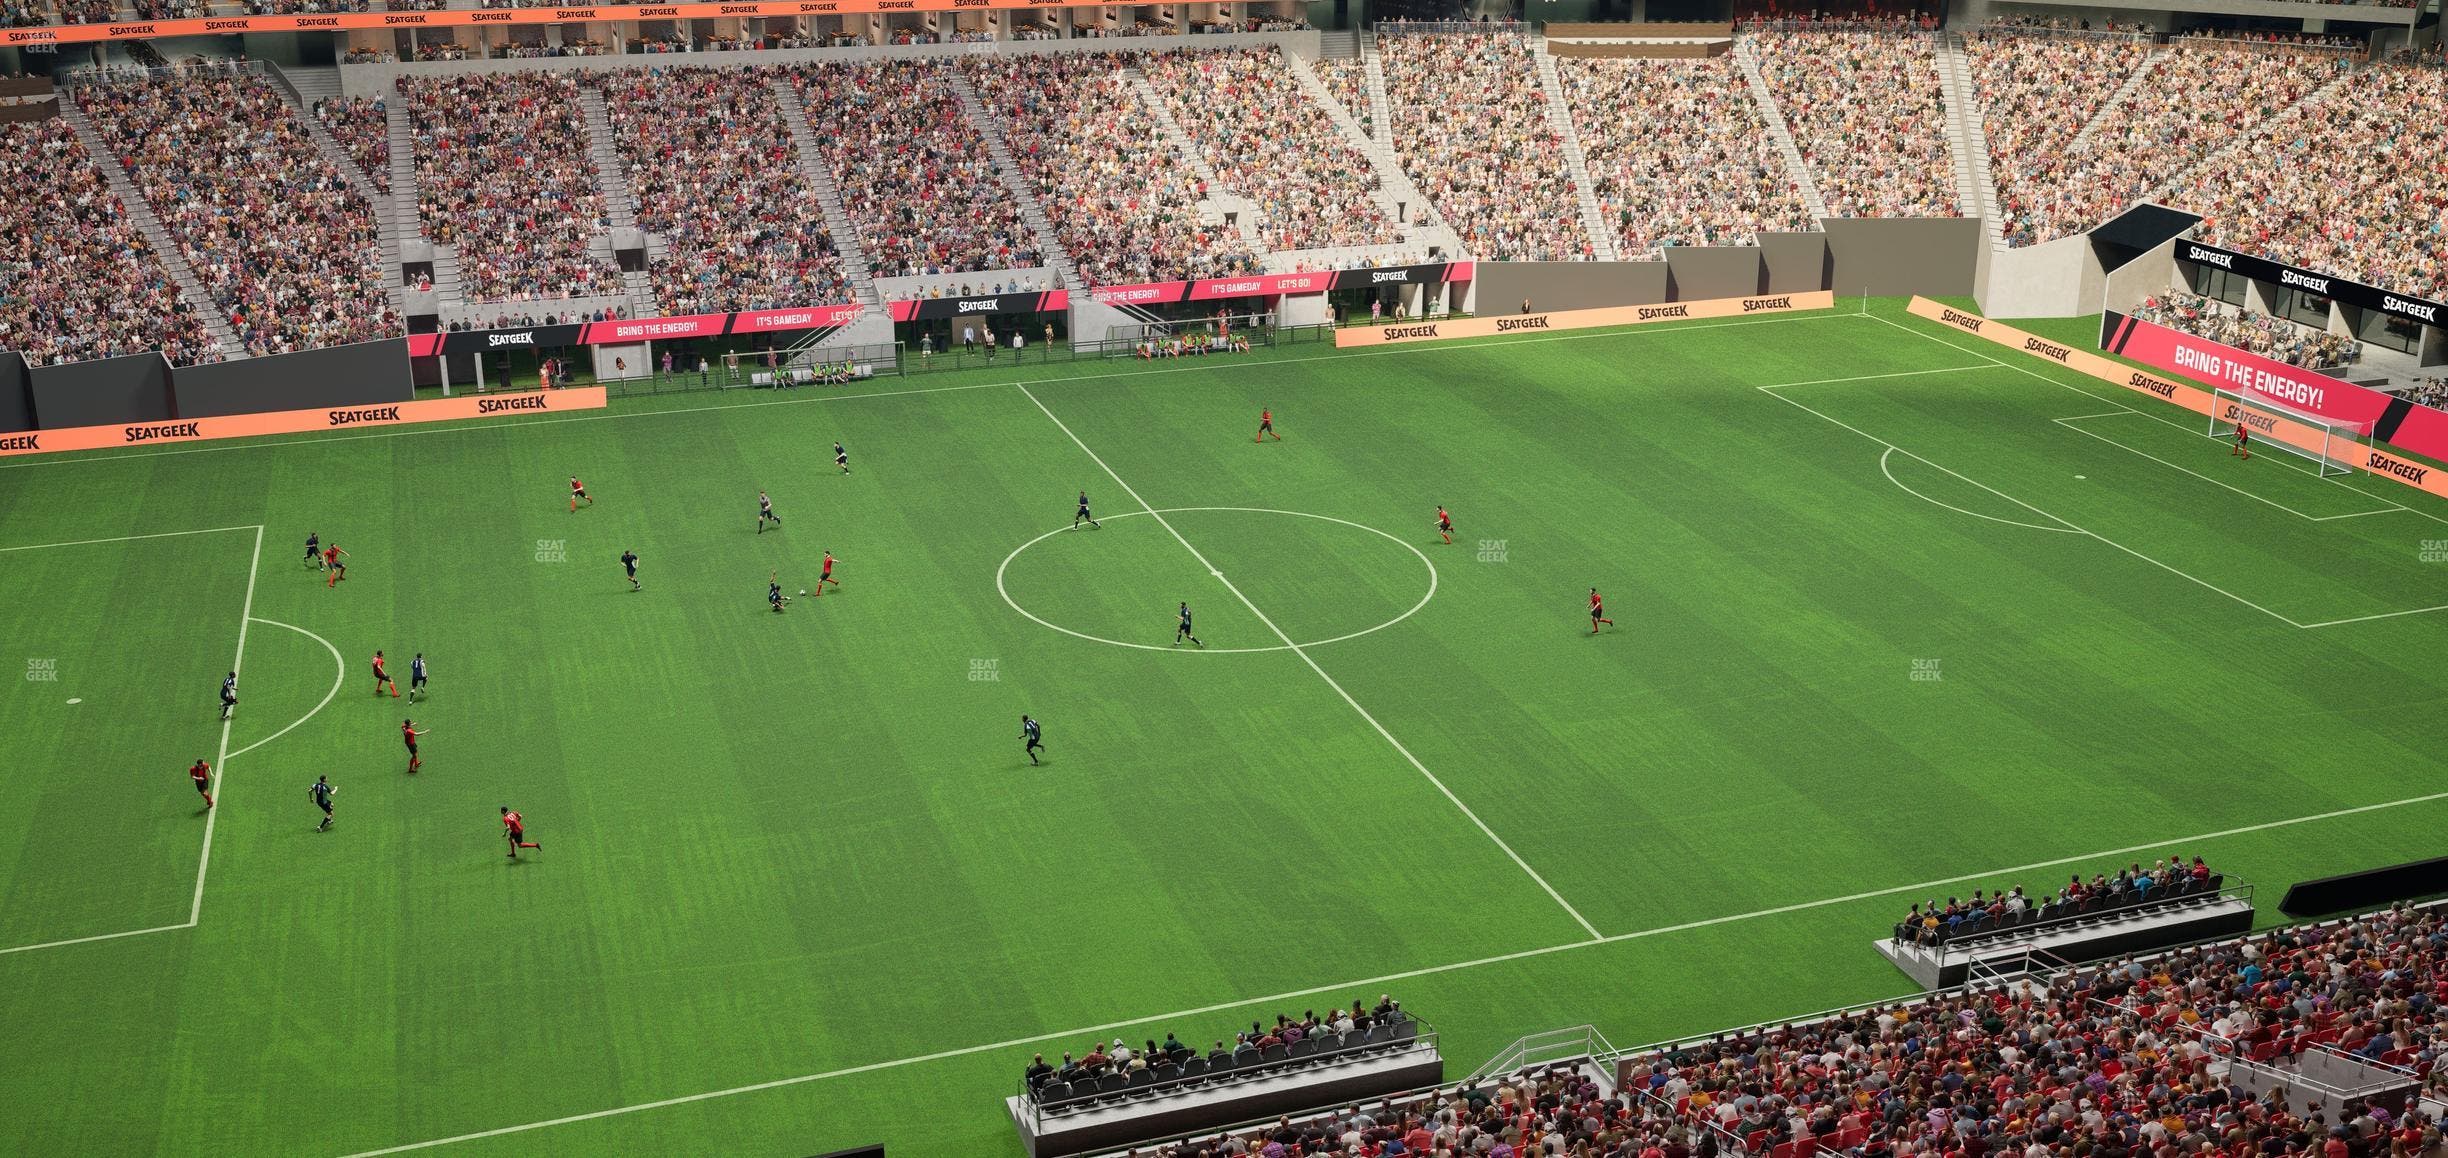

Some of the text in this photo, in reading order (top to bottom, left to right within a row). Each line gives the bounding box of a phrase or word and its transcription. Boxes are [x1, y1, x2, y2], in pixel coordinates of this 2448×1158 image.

[639, 7, 678, 17] SEATGEEK
[721, 5, 758, 15] SEATGEEK
[800, 2, 838, 12] SEATGEEK
[878, 0, 914, 10] SEATGEEK
[385, 14, 426, 25] SEATGEEK
[472, 11, 512, 22] SEATGEEK
[556, 9, 596, 20] SEATGEEK
[205, 19, 249, 31] SEATGEEK
[296, 17, 339, 27] SEATGEEK
[8, 30, 57, 42] SEATGEEK
[109, 24, 156, 37] SEATGEEK
[1372, 269, 1408, 283] SEATGEEK
[1211, 283, 1225, 294] IT'S
[1226, 281, 1261, 293] GAMEDAY
[1277, 279, 1297, 289] LET'S
[2189, 245, 2437, 323] SEATGEEK SEATGEEK SEATGEEK
[1128, 288, 1160, 300] ENERGY!
[959, 298, 998, 313] SEATGEEK
[1742, 297, 1791, 312] SEATGEEK
[1638, 305, 1688, 320] SEATGEEK
[756, 315, 772, 327] IT'S
[773, 313, 813, 326] GAMEDAY
[1496, 316, 1549, 331] SEATGEEK
[617, 321, 698, 337] BRING THE ENERGY!
[1384, 324, 1438, 340] SEATGEEK
[489, 331, 534, 346] SEATGEEK
[1940, 308, 2177, 399] SEATGEEK SEATGEEK SEATGEEK
[2174, 344, 2325, 410] BRING THE ENERGY!
[125, 422, 200, 443] SEATGEEK
[329, 406, 400, 426] SEATGEEK
[478, 394, 547, 414] SEATGEEK
[2224, 404, 2278, 434] SEATGEEK
[2366, 452, 2429, 485] SEATGEEK
